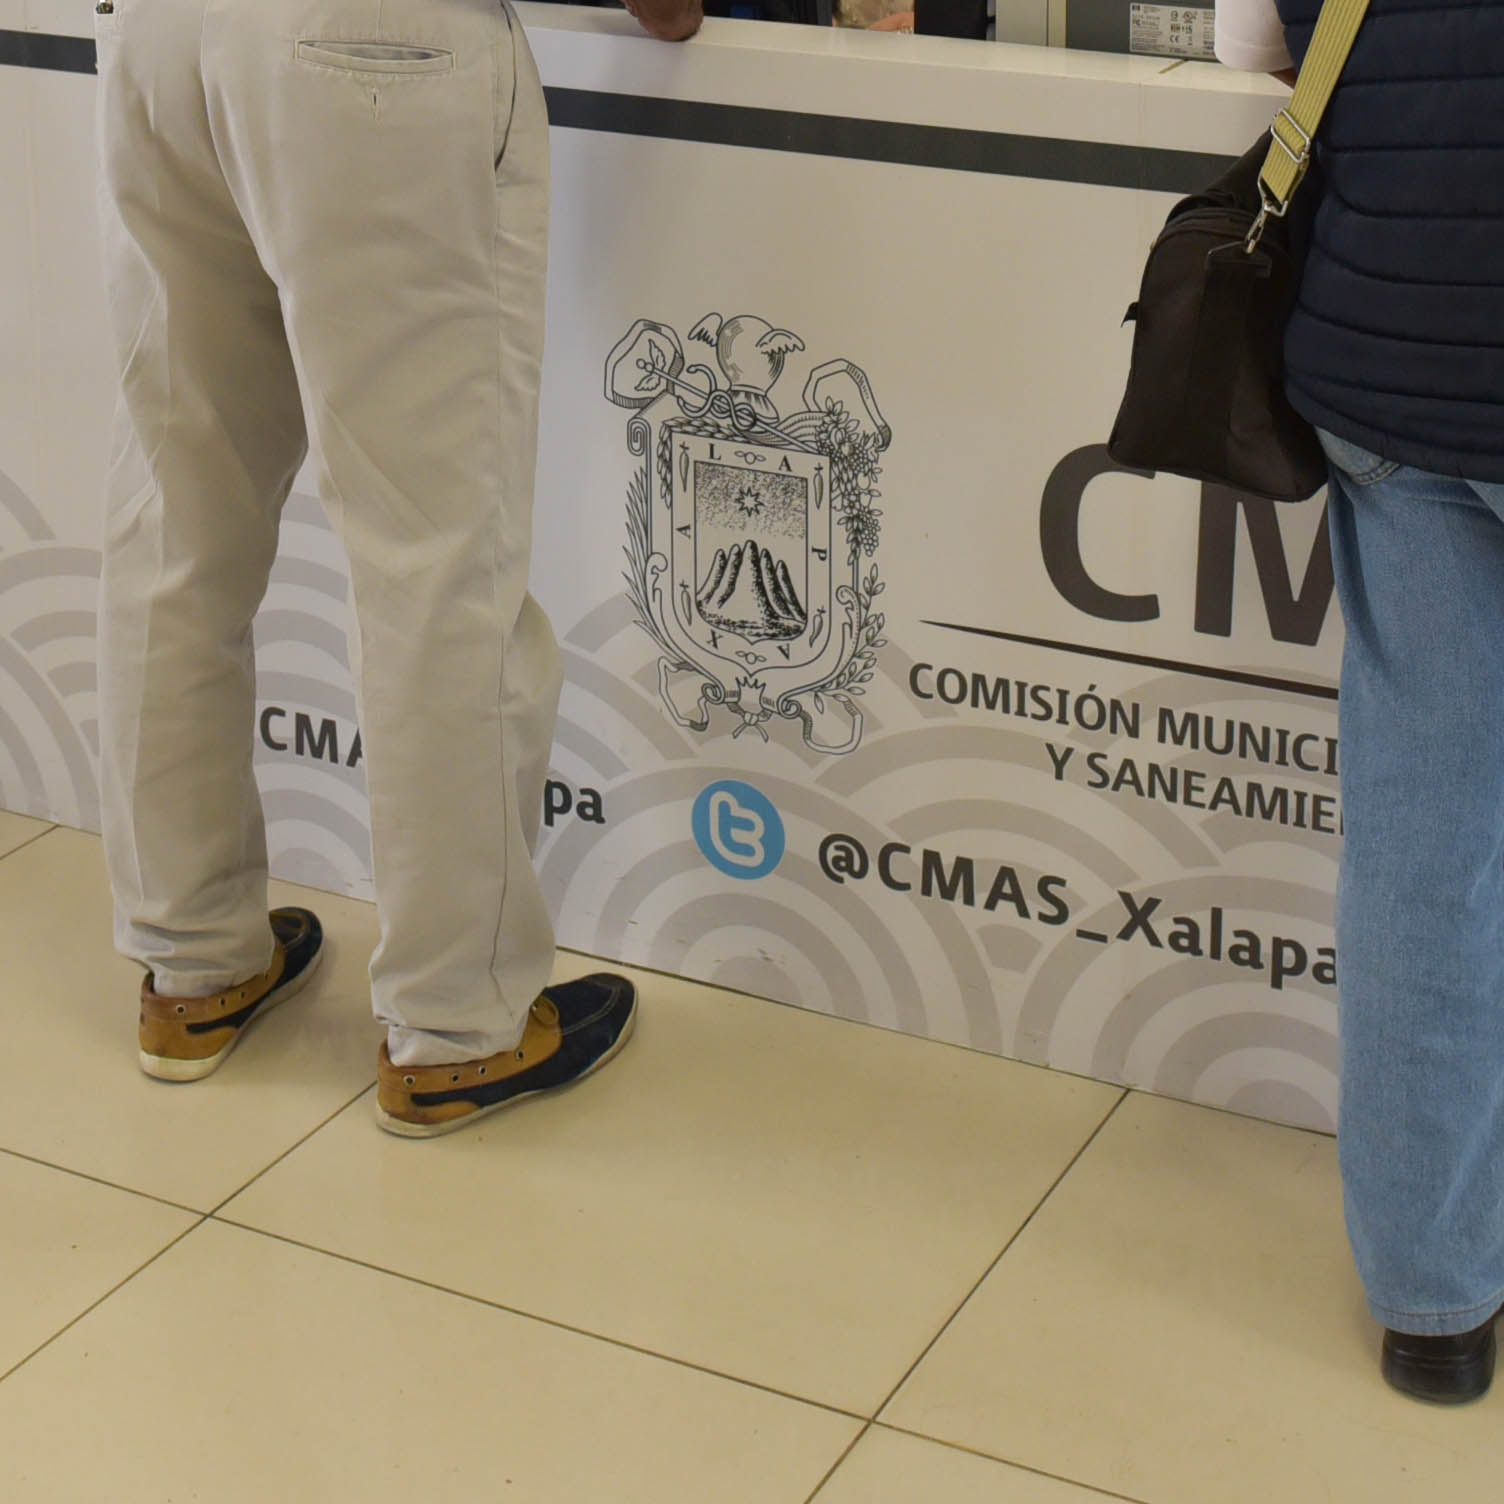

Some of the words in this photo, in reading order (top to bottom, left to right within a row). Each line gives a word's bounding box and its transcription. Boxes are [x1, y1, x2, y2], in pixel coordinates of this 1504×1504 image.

[907, 661, 1141, 739] COMISIÓN
[1044, 742, 1075, 782] Y
[1086, 752, 1344, 836] SANEAMIE
